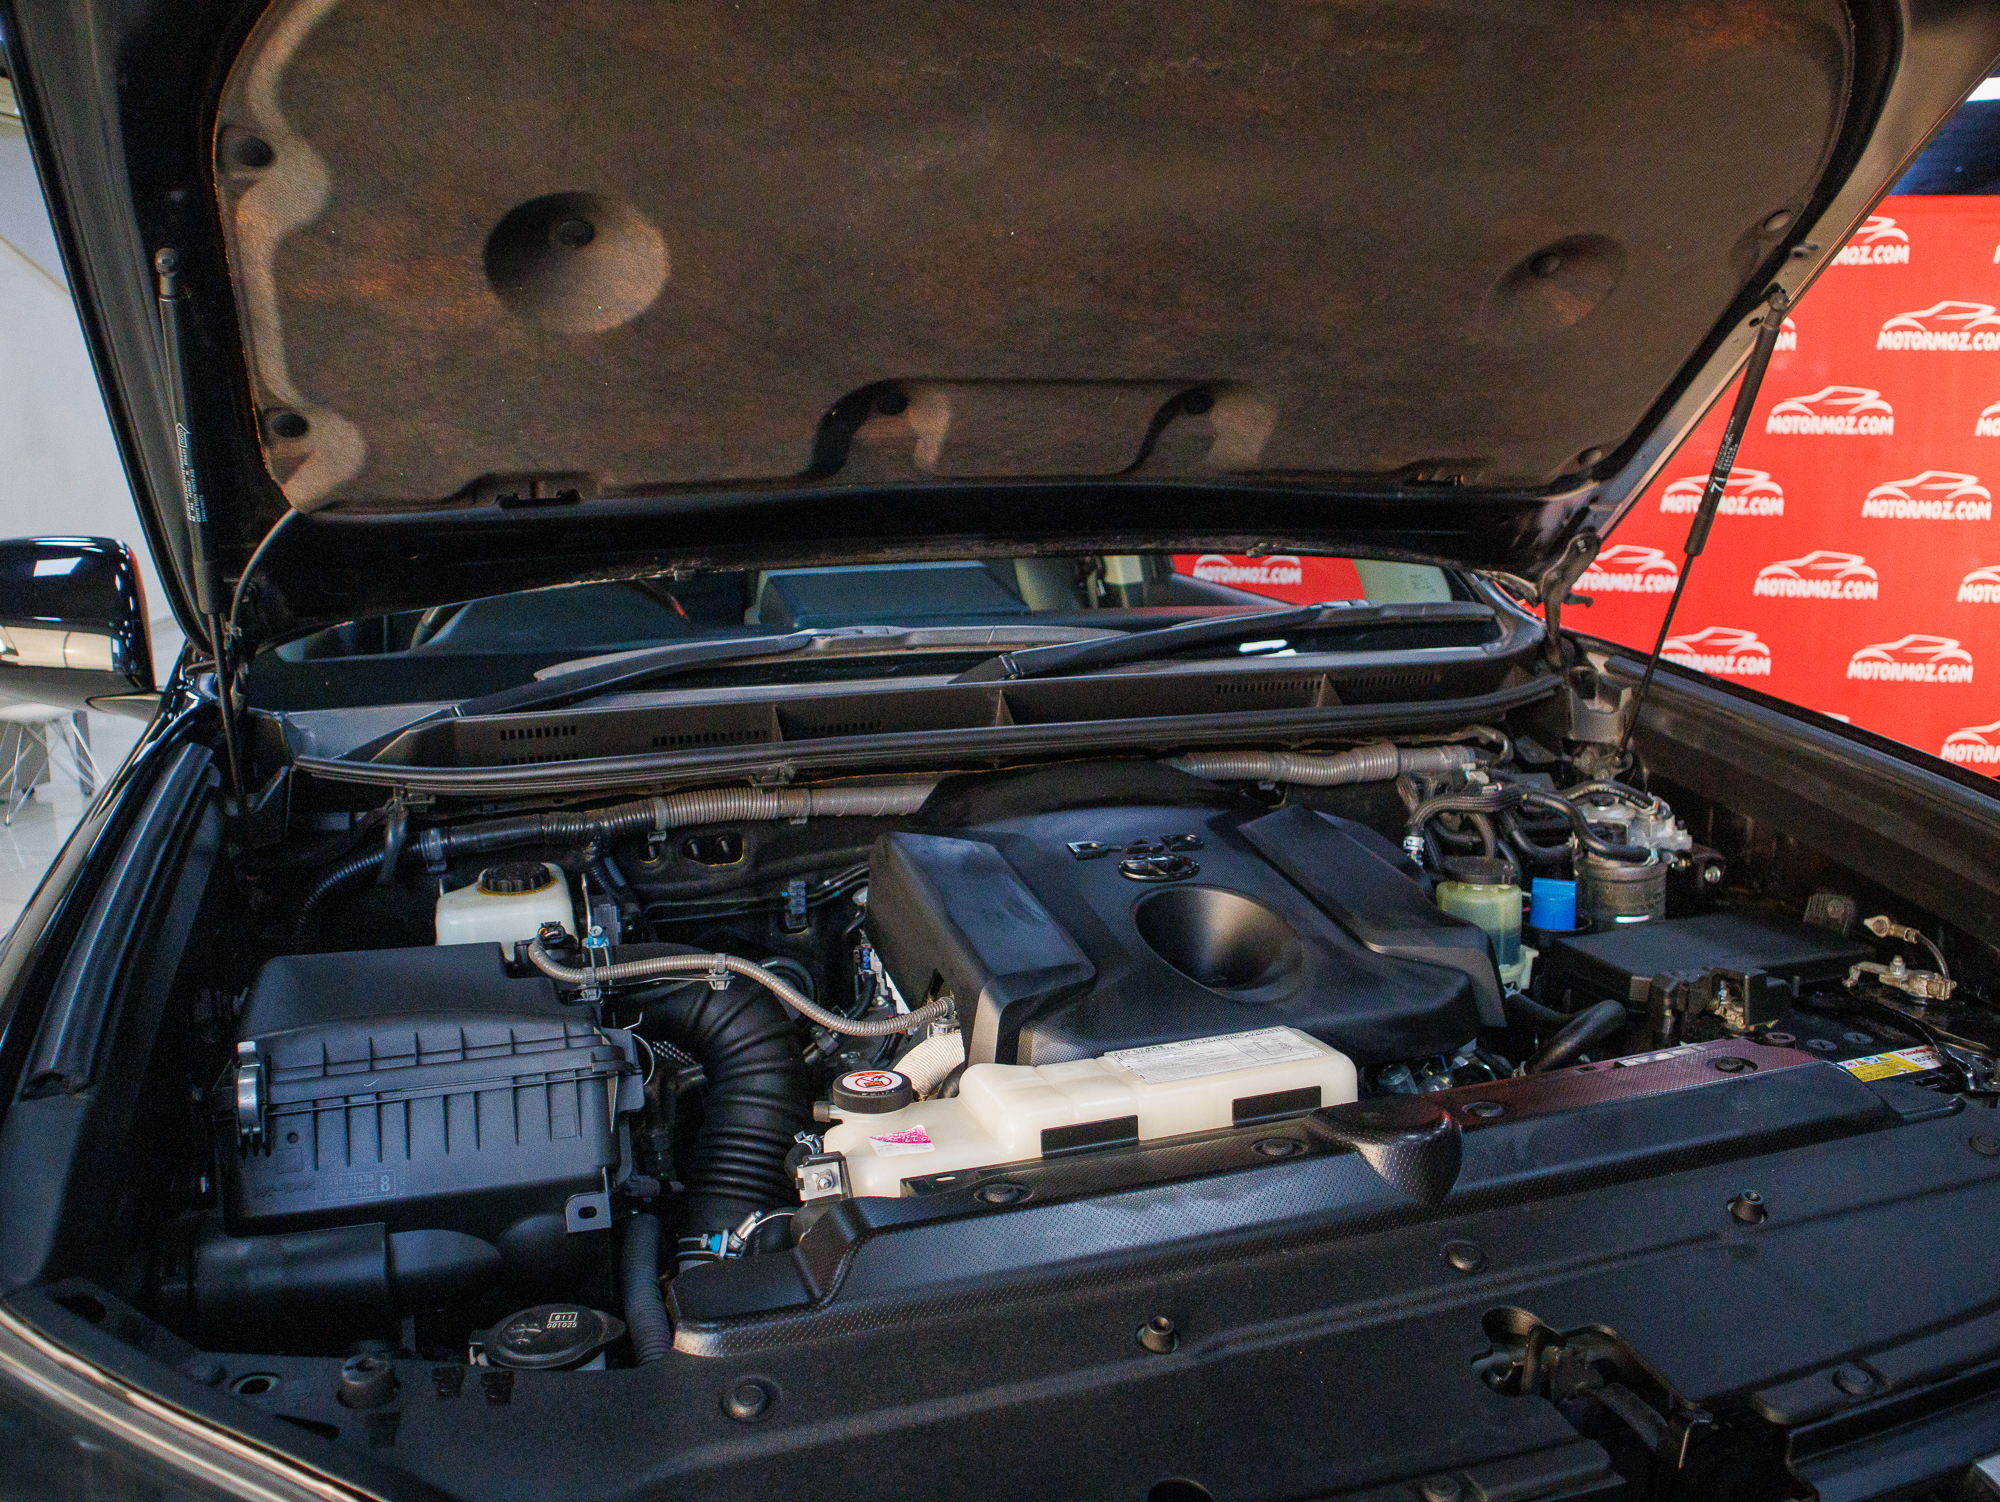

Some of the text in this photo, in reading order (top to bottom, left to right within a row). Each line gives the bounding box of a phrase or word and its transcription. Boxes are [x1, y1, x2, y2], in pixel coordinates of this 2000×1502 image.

[1765, 415, 1895, 436] MOTORMOZ.COM
[1861, 498, 1993, 521] MOTORMOZ.COM
[1753, 577, 1879, 601] MOTORMOZ.COM
[1846, 660, 1974, 684] MOTORMOZ.COM
